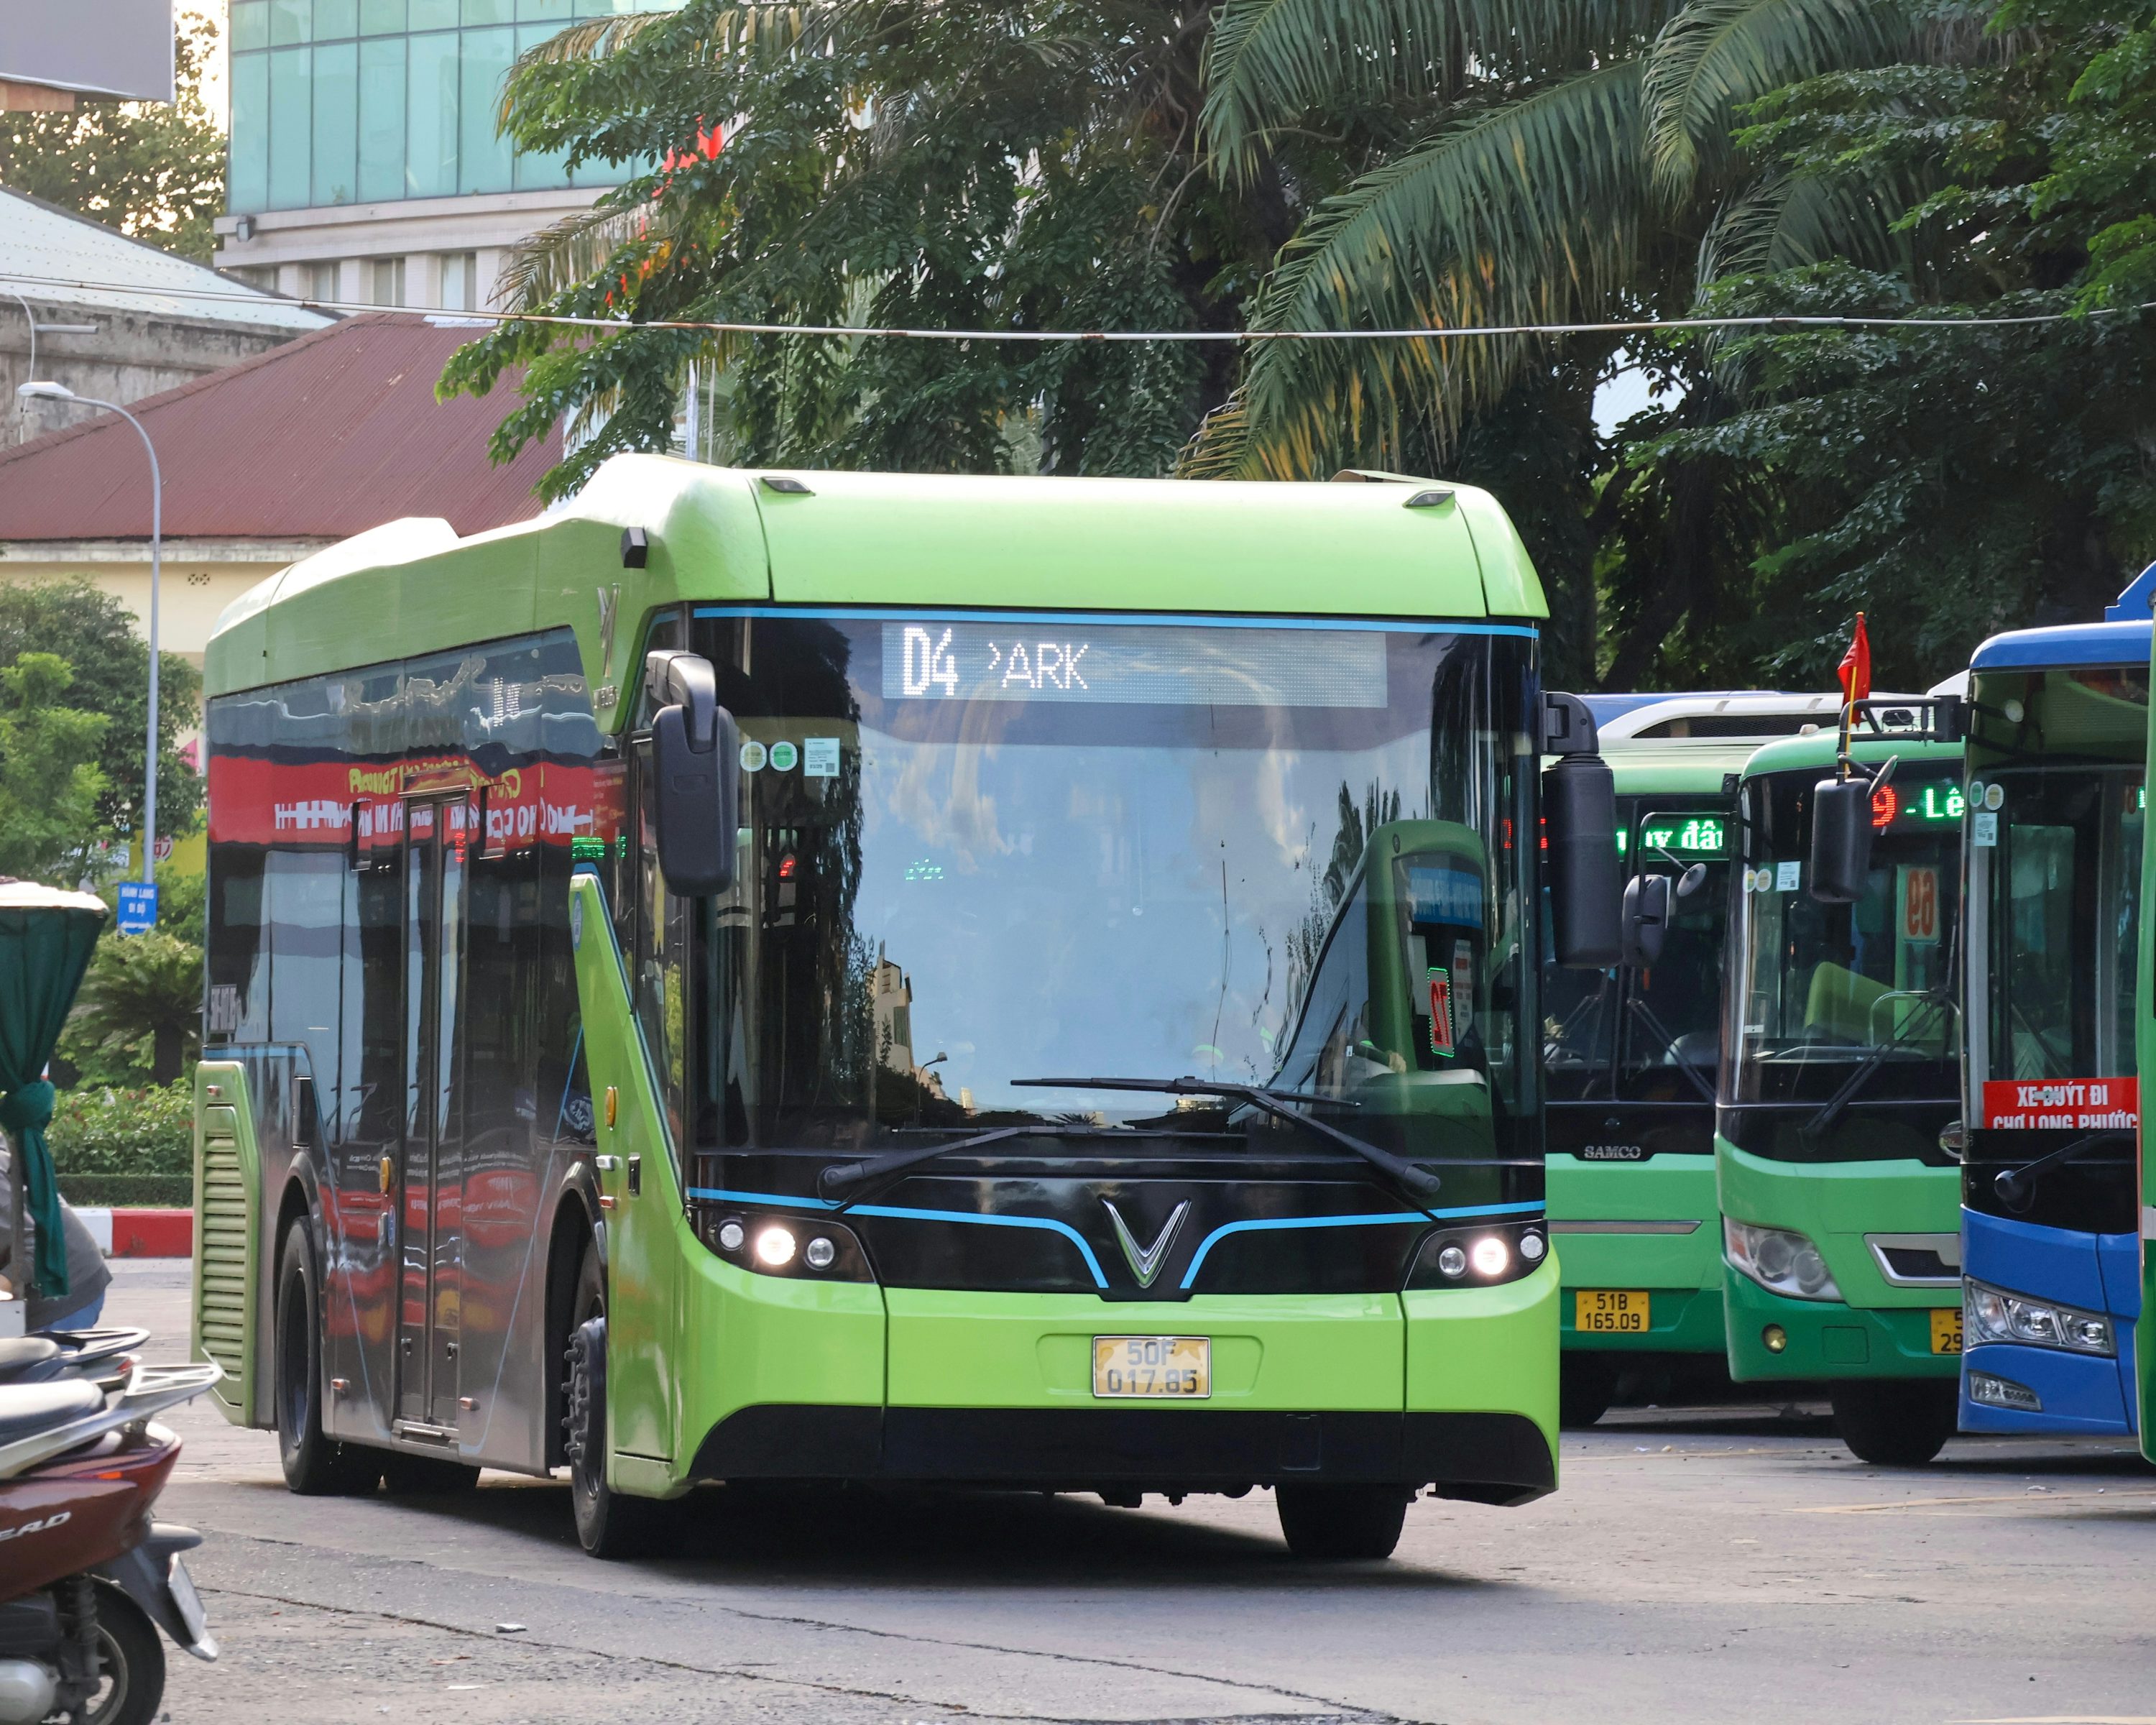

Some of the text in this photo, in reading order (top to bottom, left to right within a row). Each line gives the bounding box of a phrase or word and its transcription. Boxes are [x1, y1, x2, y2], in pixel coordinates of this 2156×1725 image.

[903, 627, 958, 696] D4
[2017, 1086, 2038, 1107] XE
[2089, 1085, 2108, 1105] ĐI
[1584, 1146, 1641, 1159] SAMCO
[1597, 1293, 1628, 1310] 51B
[1585, 1312, 1641, 1330] 165.09
[1127, 1340, 1176, 1366] 50F
[1107, 1368, 1197, 1393] 017.85
